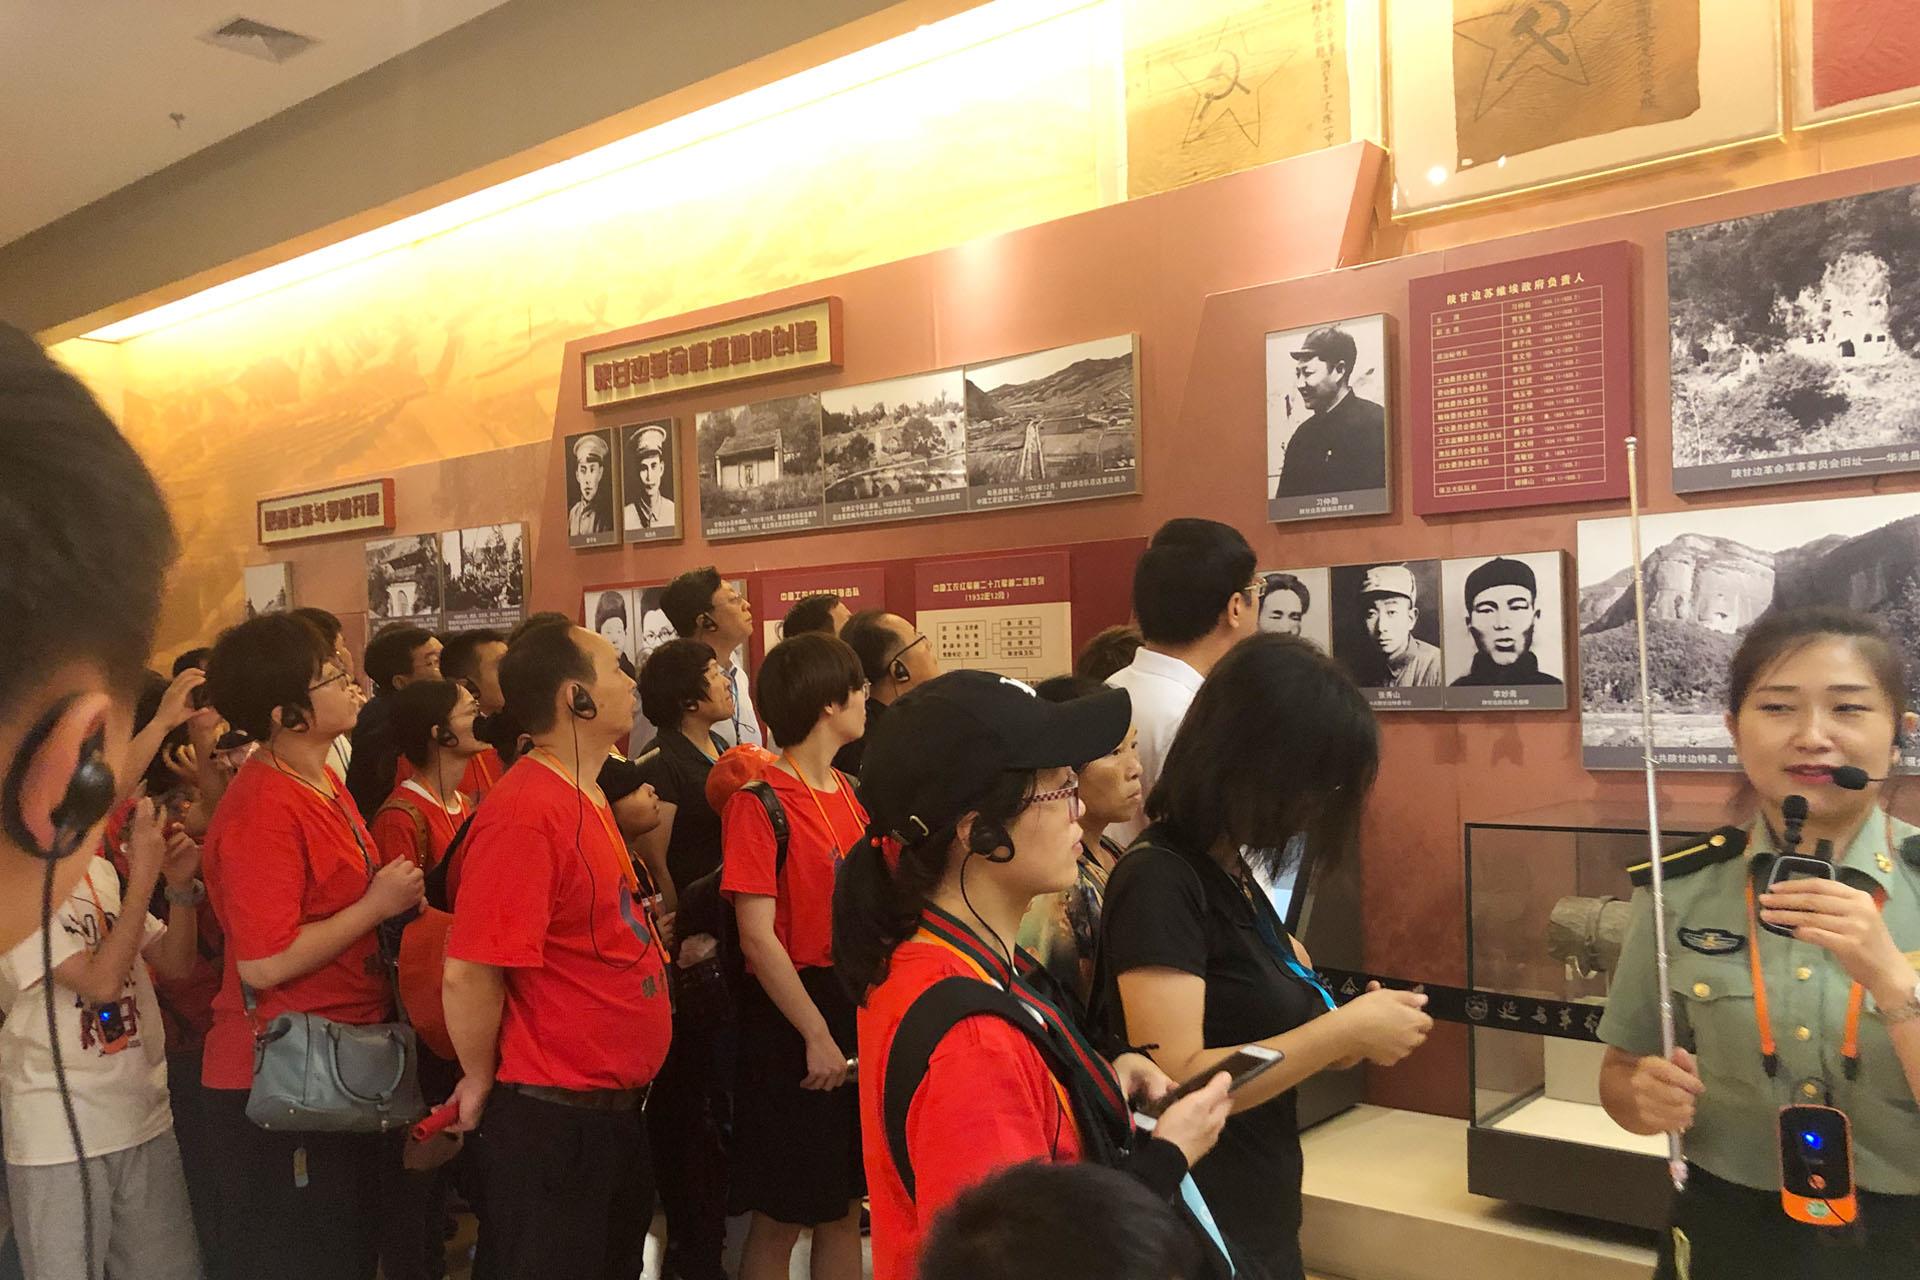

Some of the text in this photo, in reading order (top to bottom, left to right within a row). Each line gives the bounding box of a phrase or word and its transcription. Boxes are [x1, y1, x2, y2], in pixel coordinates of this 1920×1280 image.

[1446, 272, 1584, 305] 陕甘边苏维埃政府负责人
